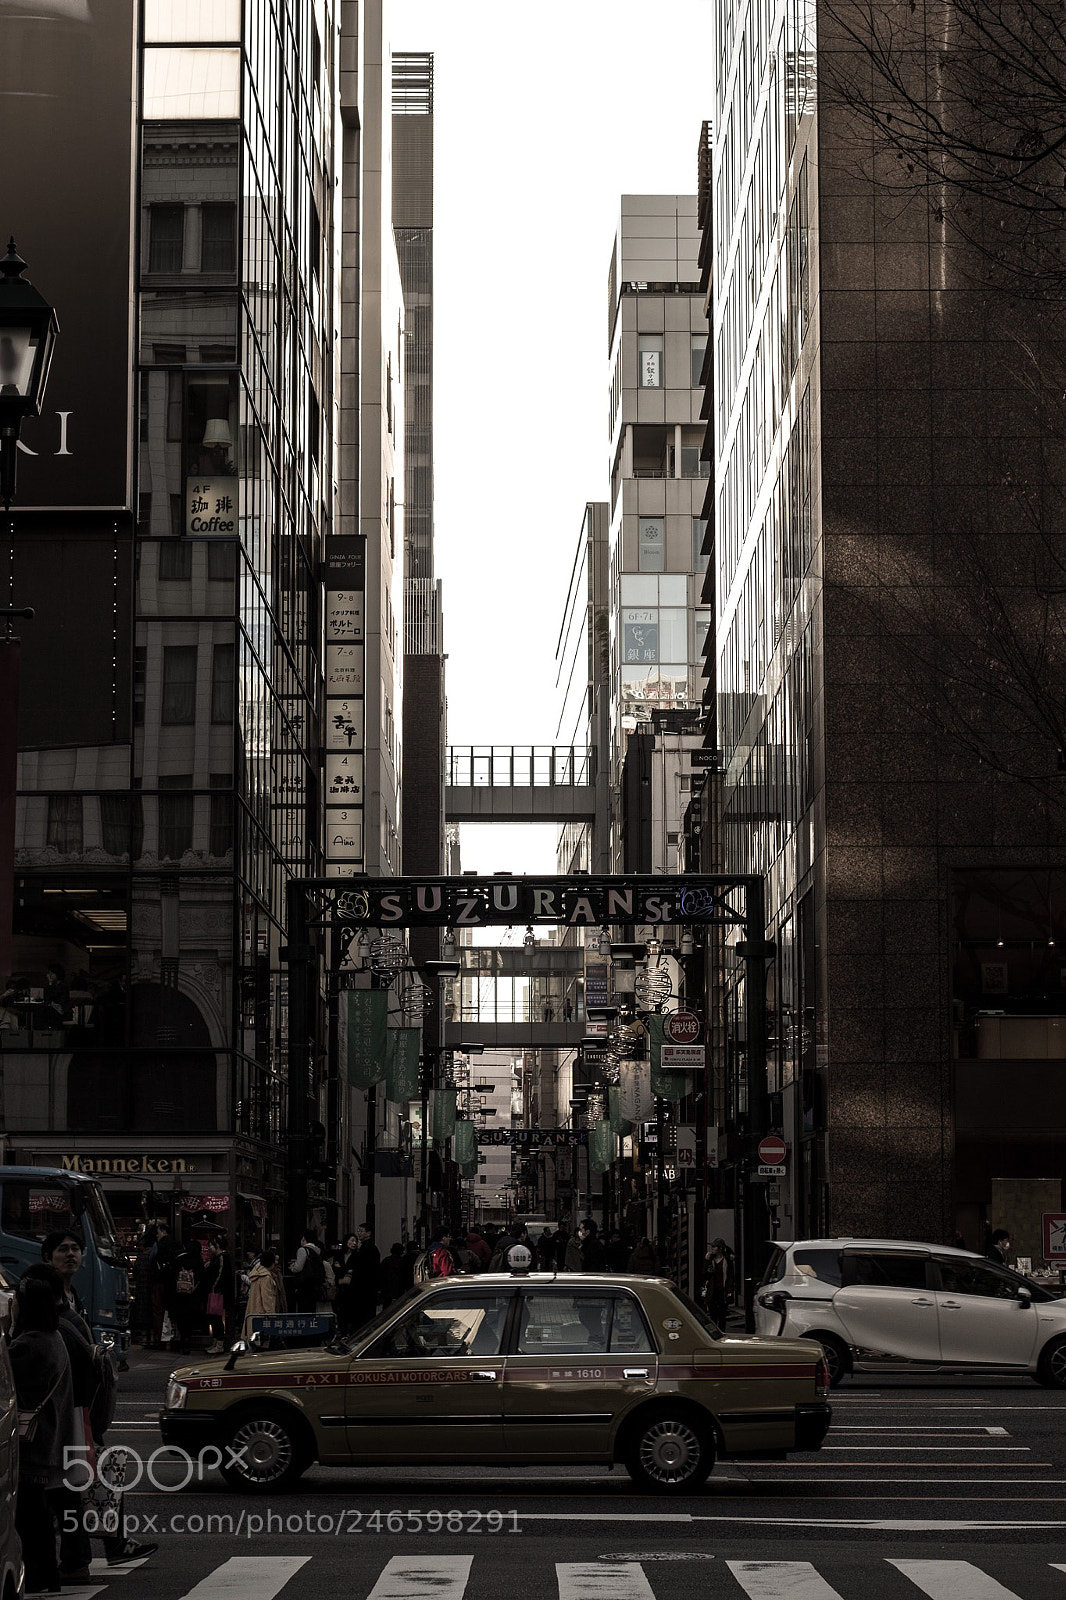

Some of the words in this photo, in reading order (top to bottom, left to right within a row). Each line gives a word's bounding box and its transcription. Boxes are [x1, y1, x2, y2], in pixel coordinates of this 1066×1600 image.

[192, 485, 212, 494] 4F
[191, 497, 234, 514] 珈琲
[191, 516, 234, 533] Coffee
[627, 648, 656, 661] 銀座
[341, 702, 348, 711] 5
[341, 757, 348, 765] 4
[341, 811, 348, 820] 3
[380, 883, 634, 925] SUZURAN
[644, 896, 672, 922] St
[671, 1022, 697, 1034] 消火栓
[481, 1132, 566, 1145] SUZURAN
[62, 1155, 187, 1173] Manneken
[294, 1374, 339, 1385] TAXI
[350, 1372, 399, 1383] KOKUSAI
[401, 1371, 468, 1382] MOTORCARS
[576, 1369, 601, 1378] 1610
